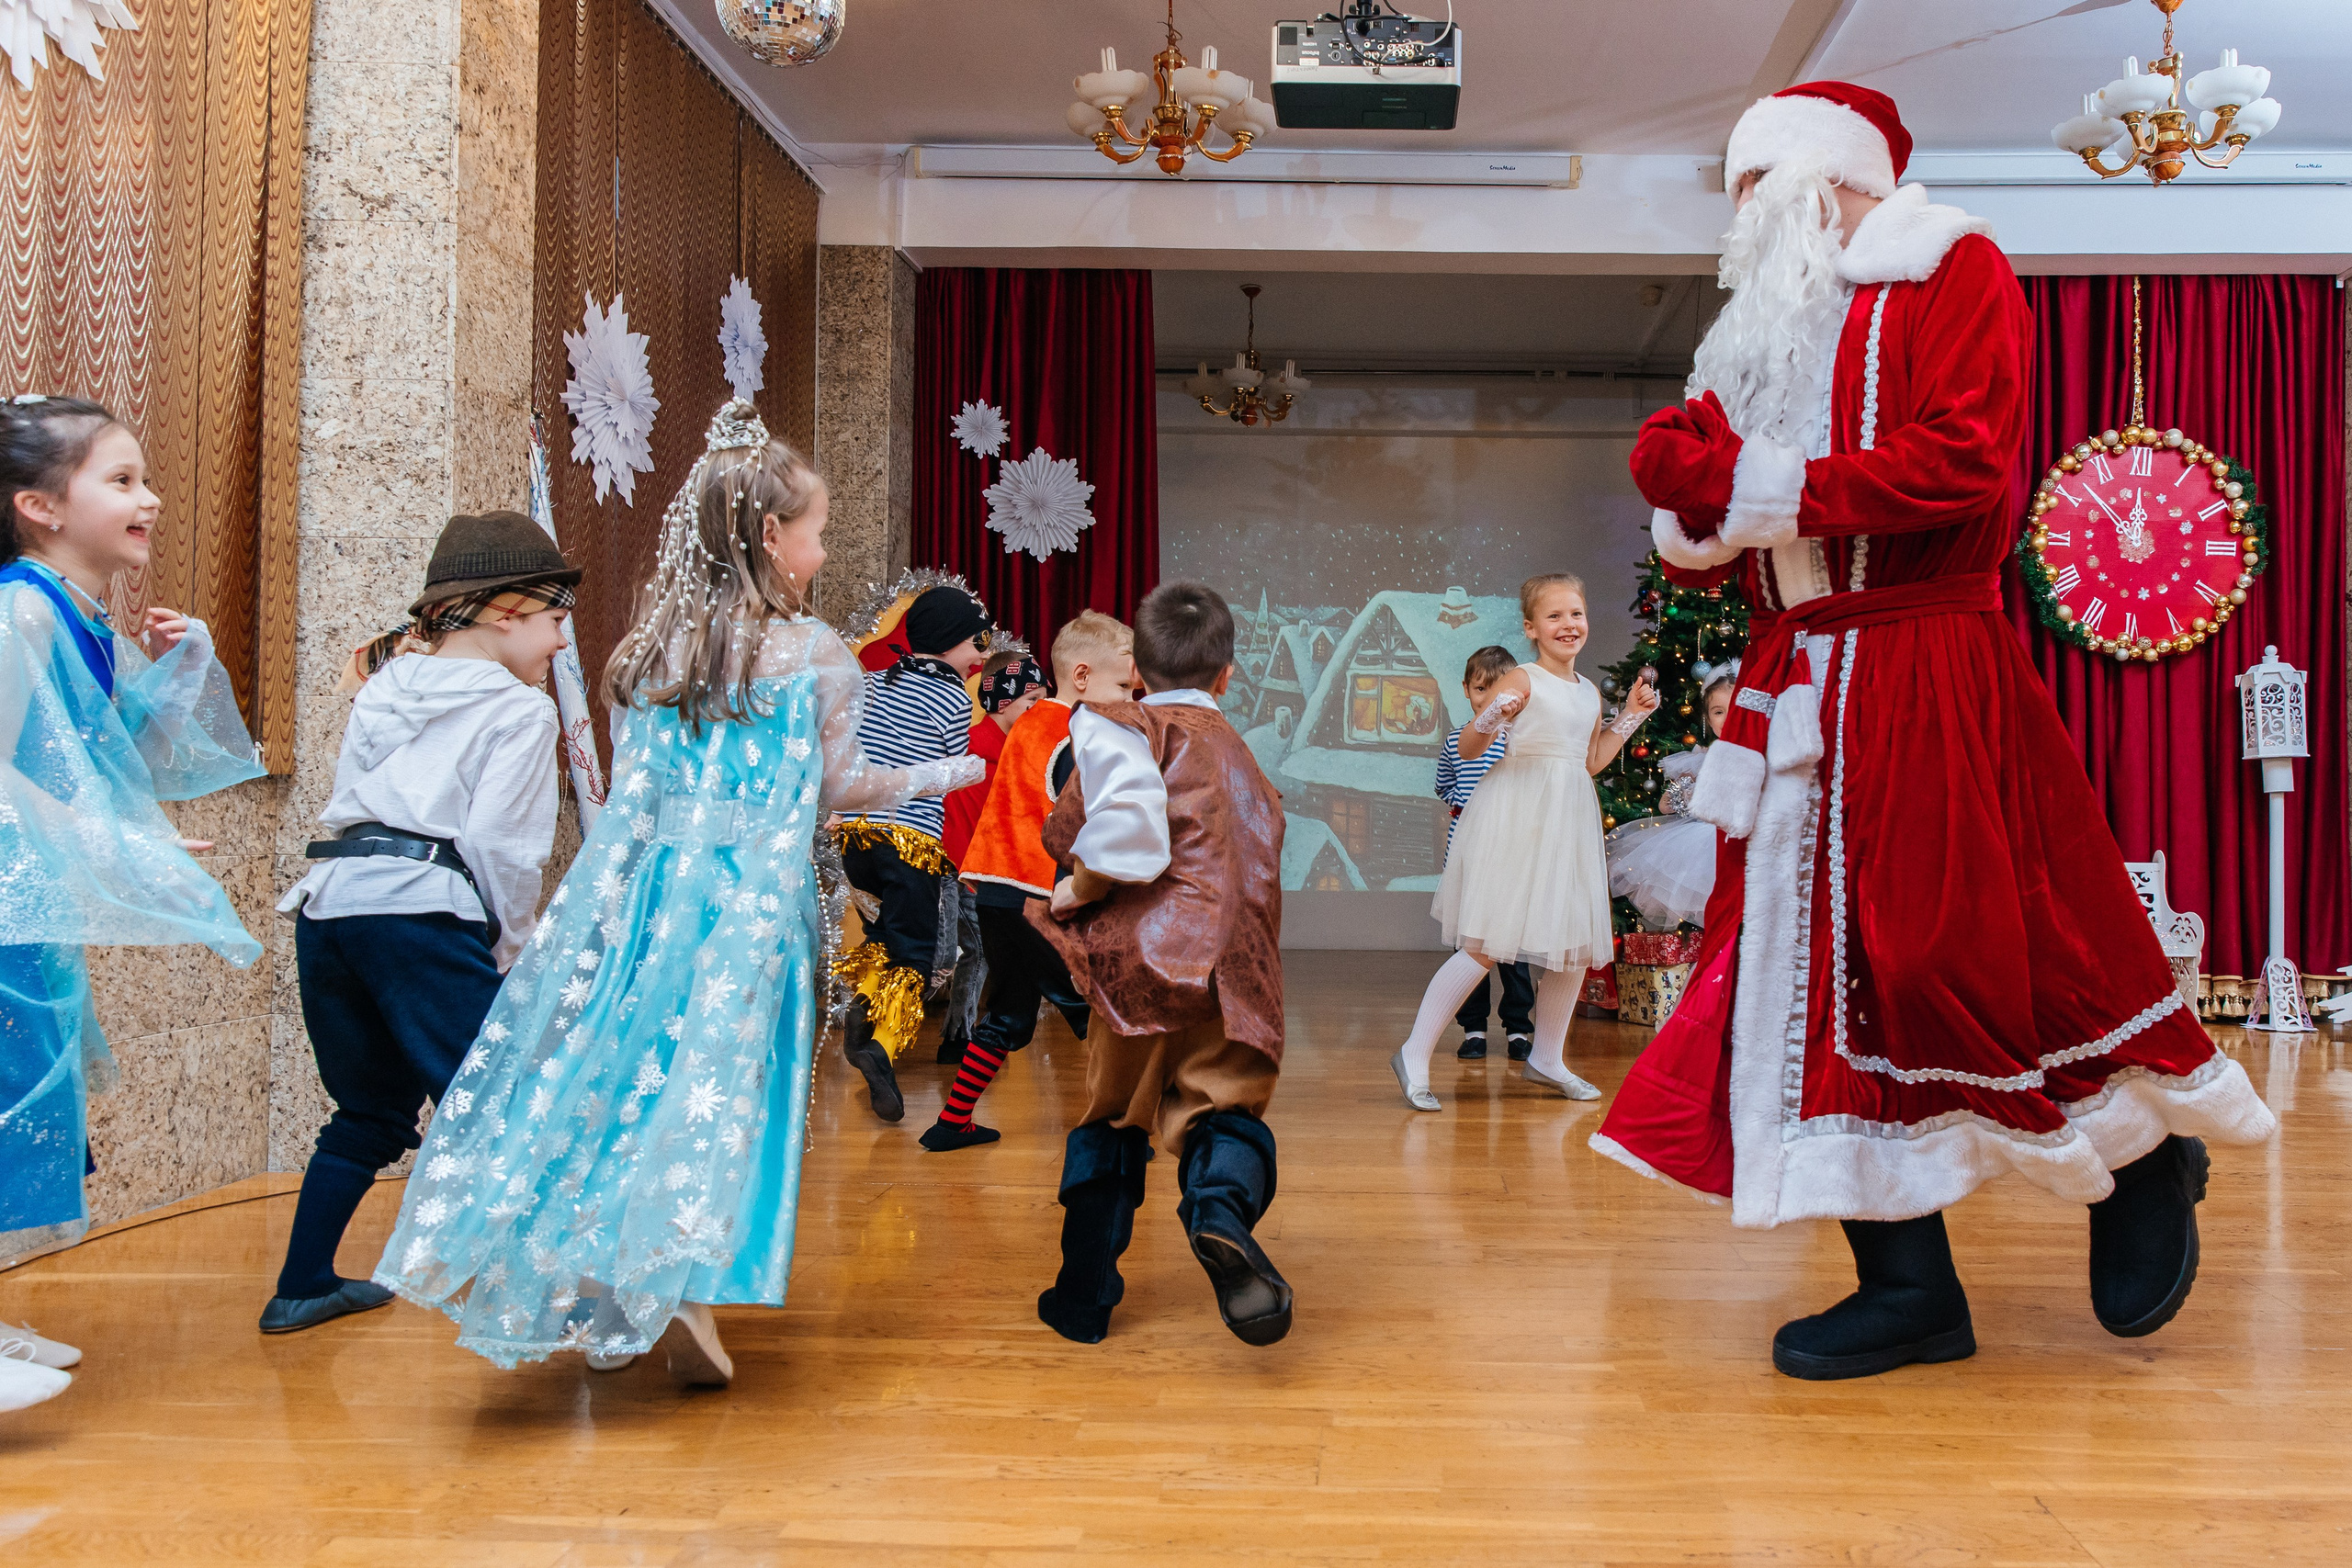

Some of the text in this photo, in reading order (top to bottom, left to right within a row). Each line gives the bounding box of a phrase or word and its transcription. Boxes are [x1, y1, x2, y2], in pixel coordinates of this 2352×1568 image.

[2088, 454, 2115, 485] XI
[2129, 446, 2153, 477] XII
[2174, 464, 2195, 488] I
[2055, 484, 2083, 508] X
[2197, 499, 2228, 522] II
[2205, 539, 2237, 557] III
